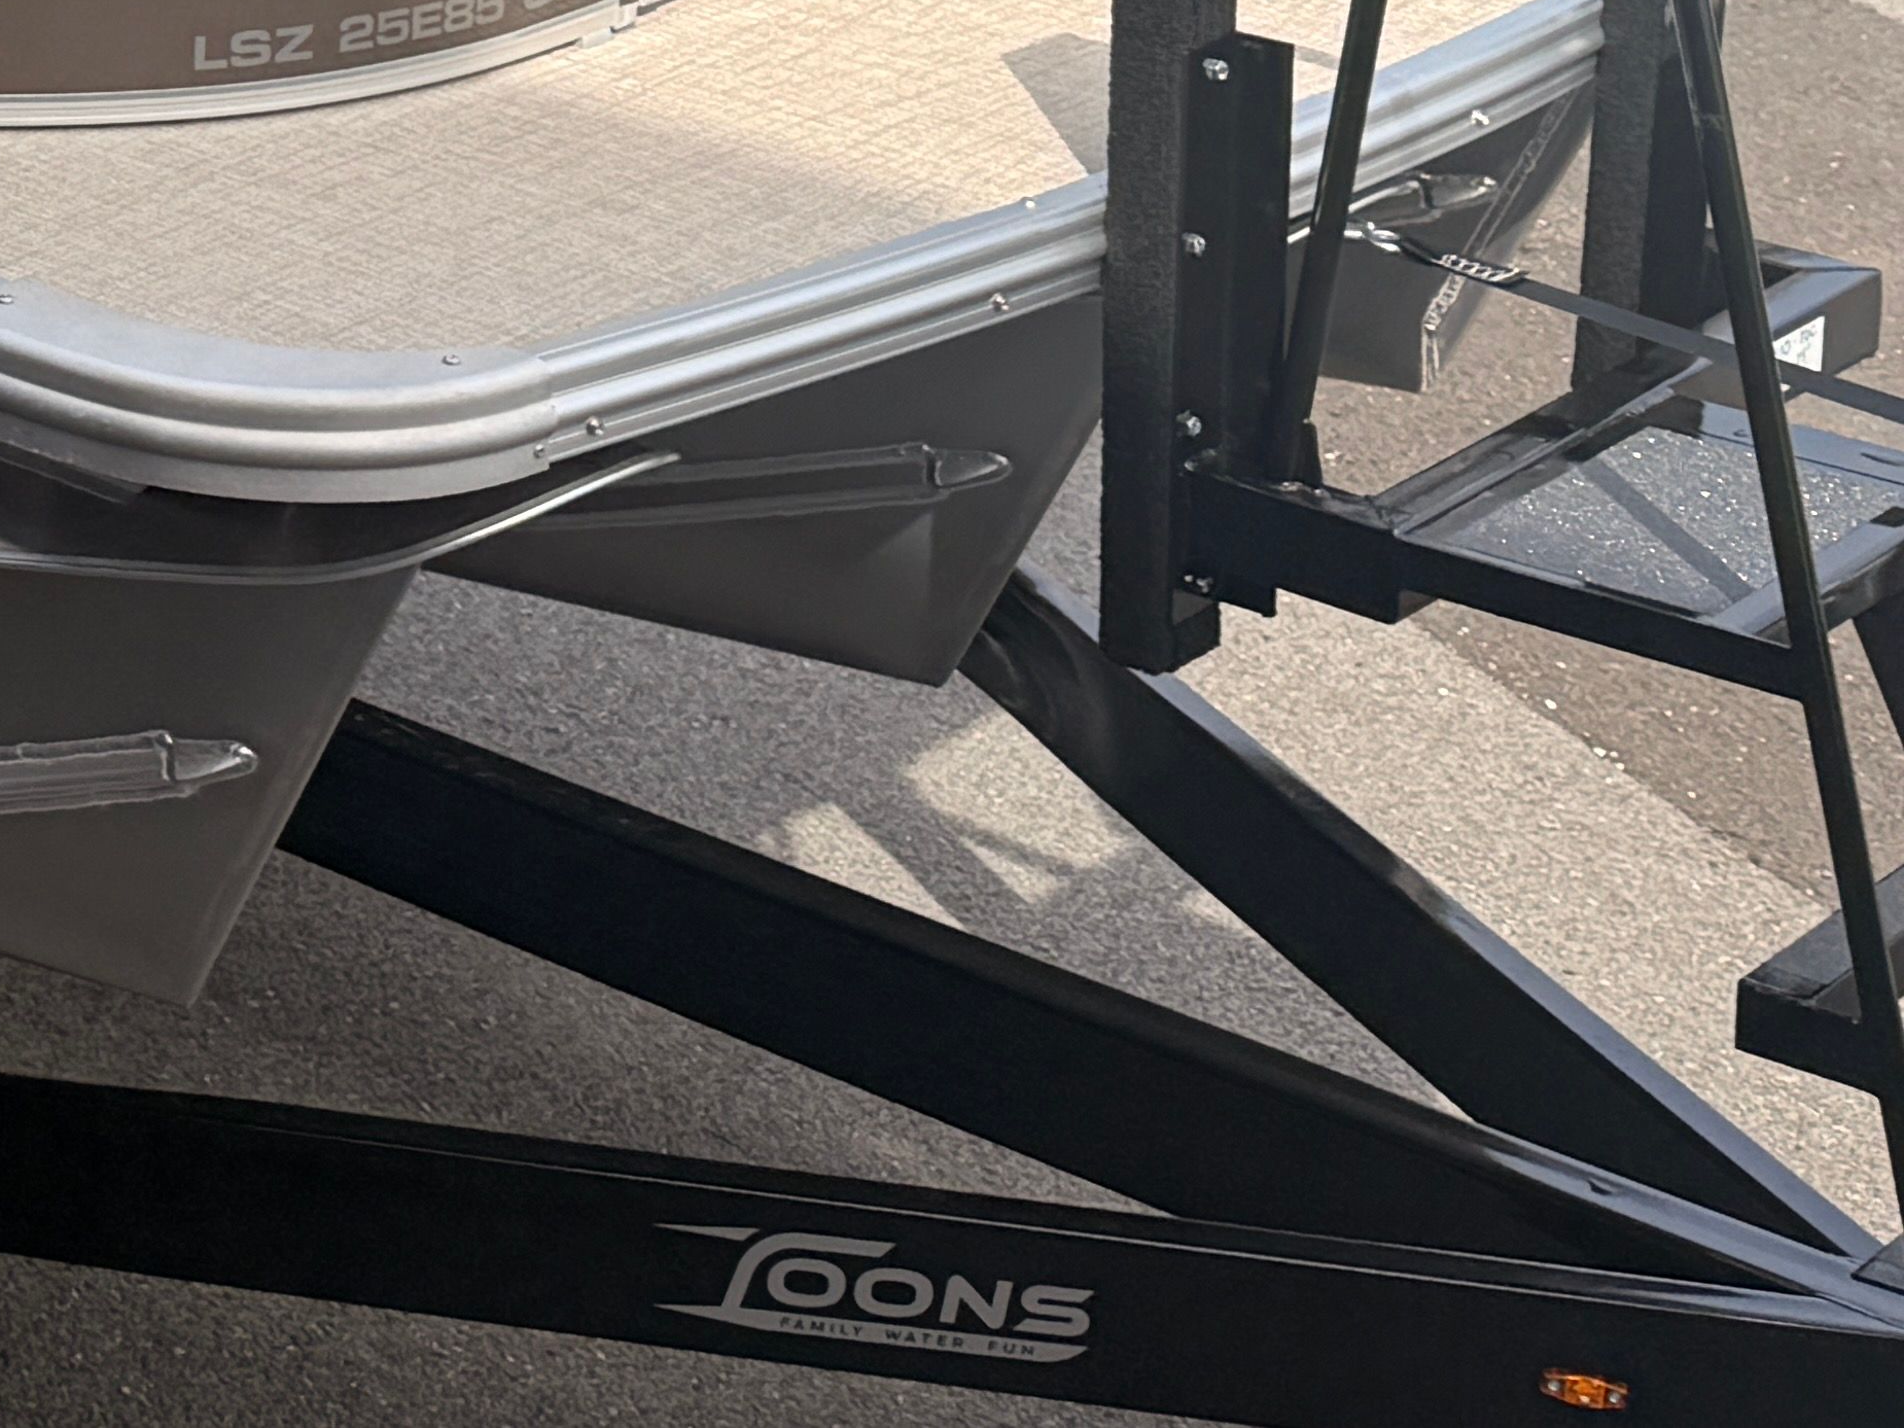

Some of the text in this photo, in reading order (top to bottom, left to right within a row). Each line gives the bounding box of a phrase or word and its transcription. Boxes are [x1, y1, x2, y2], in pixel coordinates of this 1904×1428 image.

[193, 23, 314, 71] LSZ
[653, 1223, 1094, 1339] TOONS
[778, 1316, 1037, 1357] FAMILY WATER FUN
